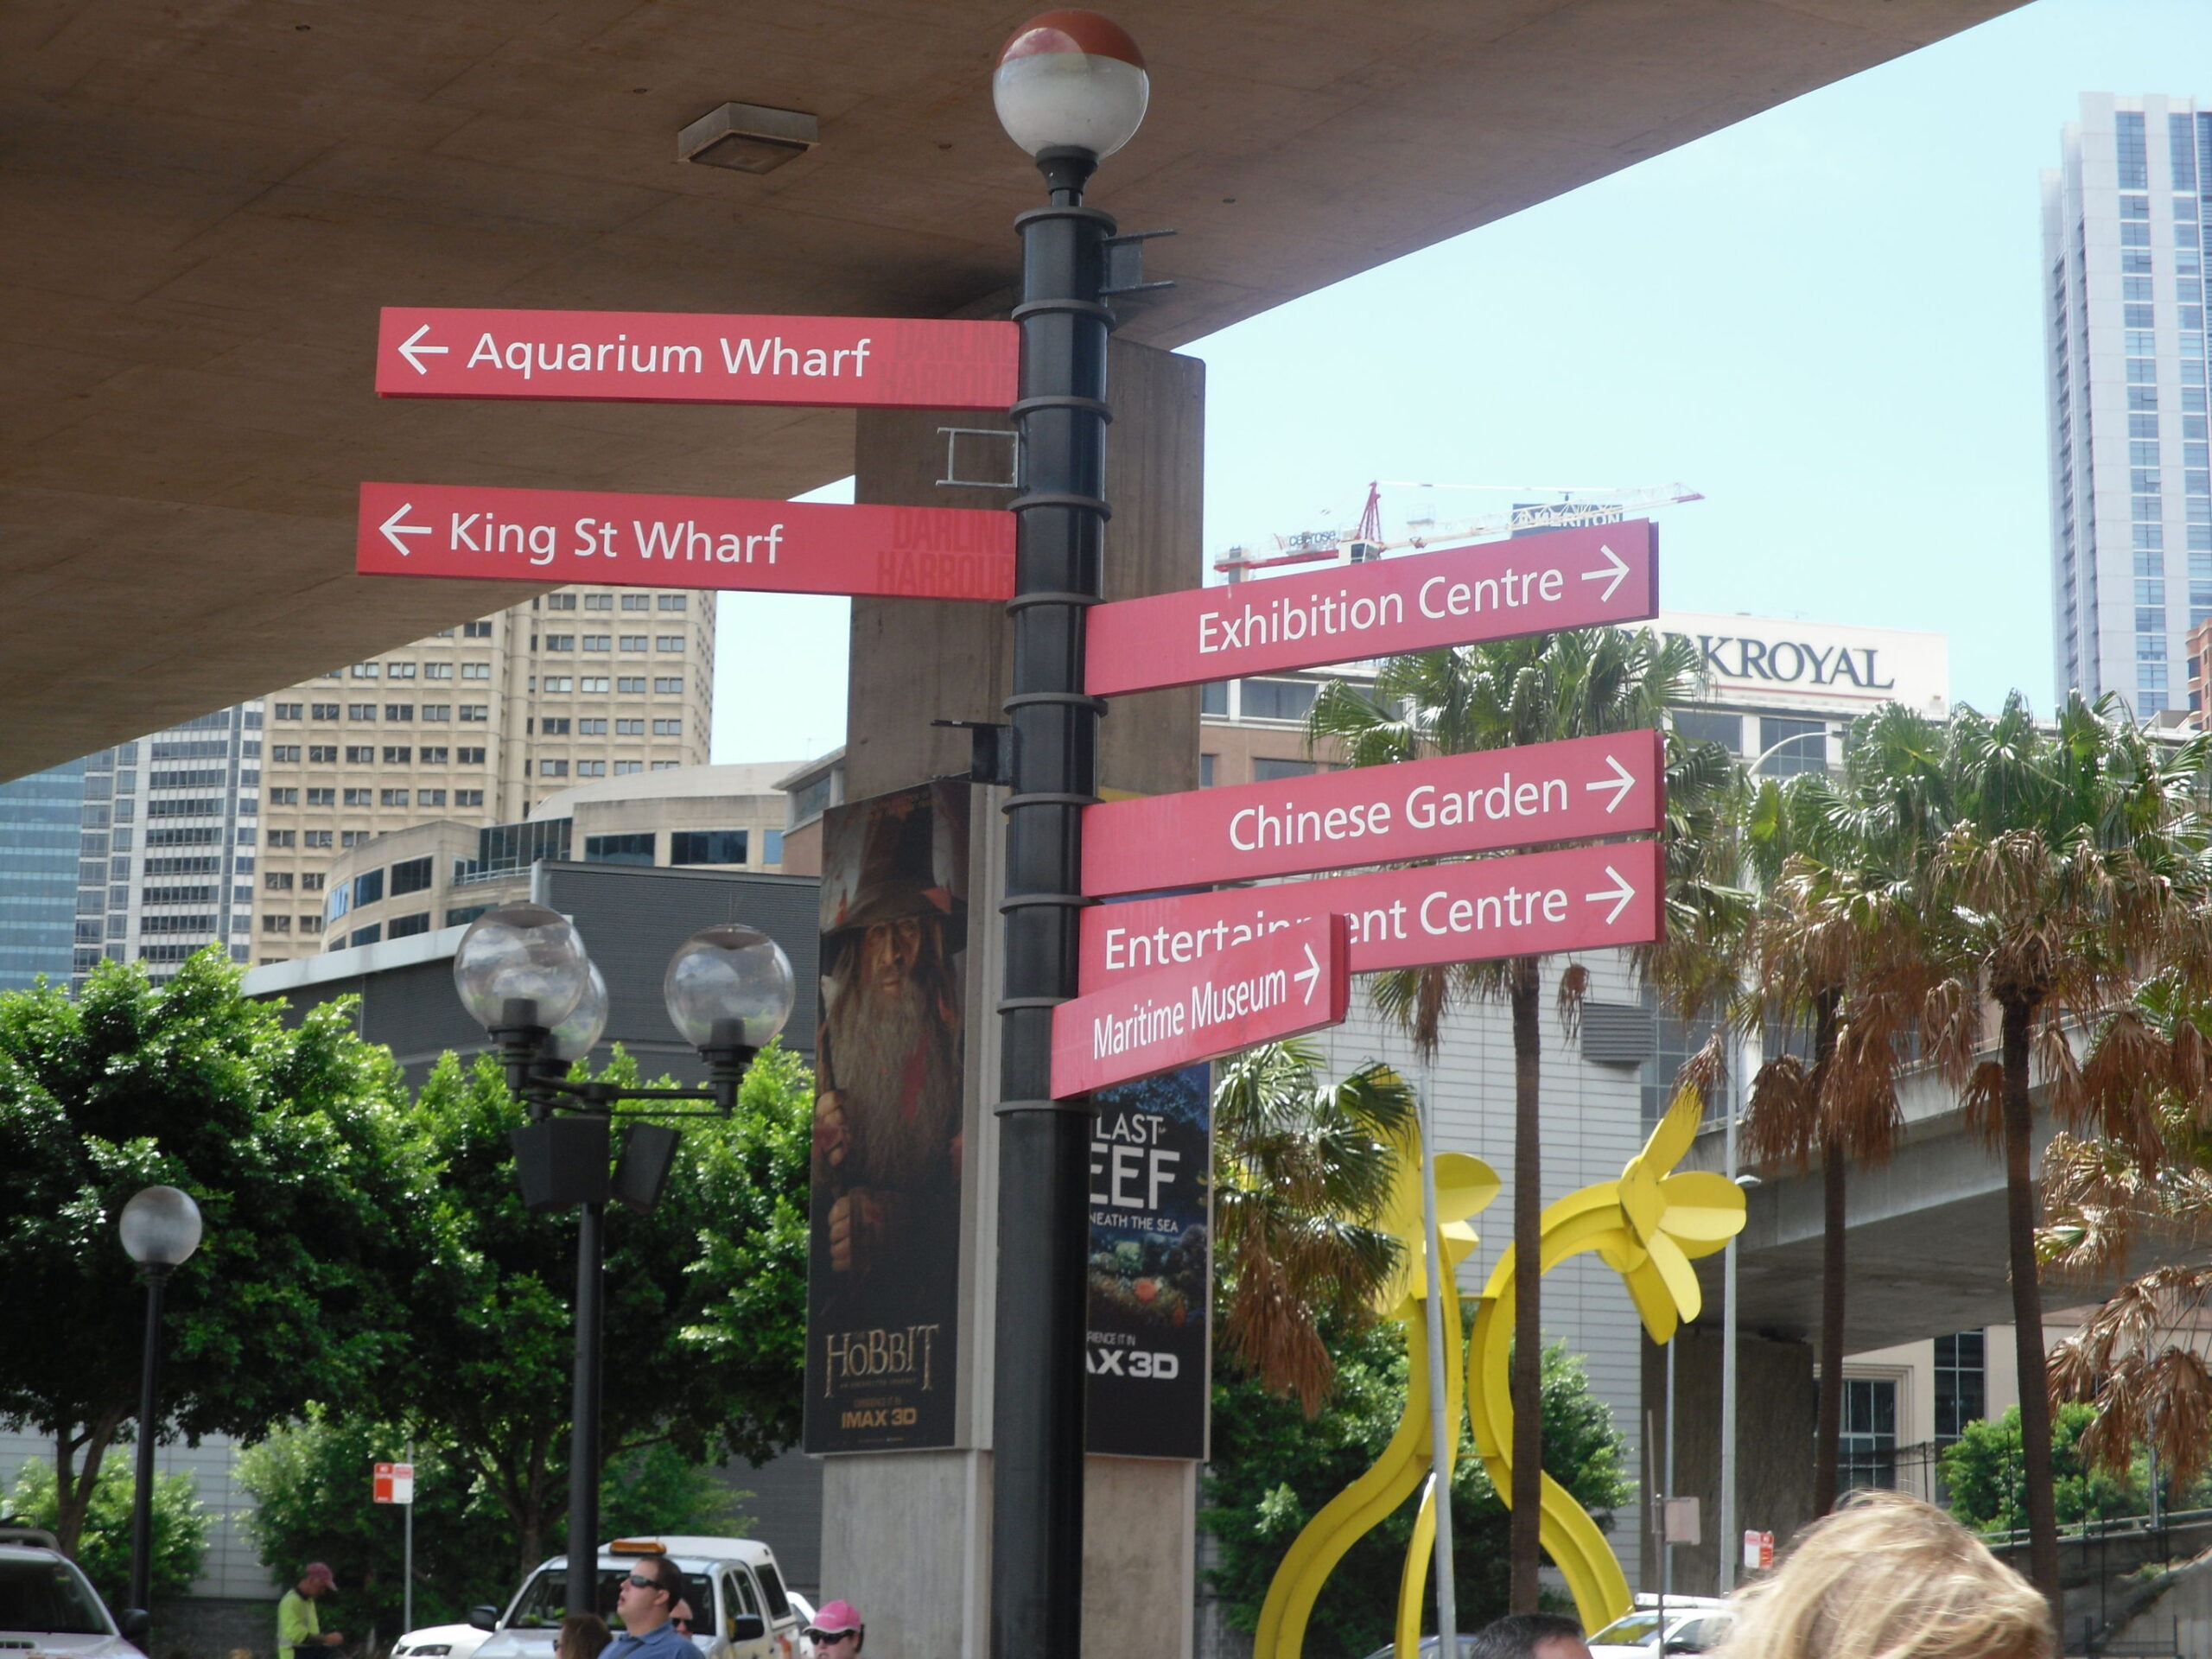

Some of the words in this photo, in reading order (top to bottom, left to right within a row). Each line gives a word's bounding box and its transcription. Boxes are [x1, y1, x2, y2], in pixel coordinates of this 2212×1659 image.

[467, 333, 702, 378] Aquarium
[720, 336, 871, 377] Wharf
[449, 512, 556, 565] King
[575, 518, 618, 558] St
[633, 520, 784, 563] Wharf
[1198, 588, 1403, 654] Exhibition
[1418, 567, 1564, 619] Centre
[1229, 801, 1391, 851] Chinese
[1405, 772, 1568, 830] Garden
[1105, 899, 1408, 970] Entertaient
[1420, 887, 1568, 935] Centre
[1093, 999, 1185, 1060] Maritime
[1191, 968, 1287, 1031] Museum
[1096, 1112, 1165, 1146] LAST
[1130, 1215, 1154, 1230] THE
[1156, 1217, 1179, 1233] SEA
[823, 1323, 940, 1399] HOBBIT
[1128, 1351, 1179, 1380] 3D
[841, 1410, 887, 1429] IMAX
[891, 1407, 918, 1426] 3D
